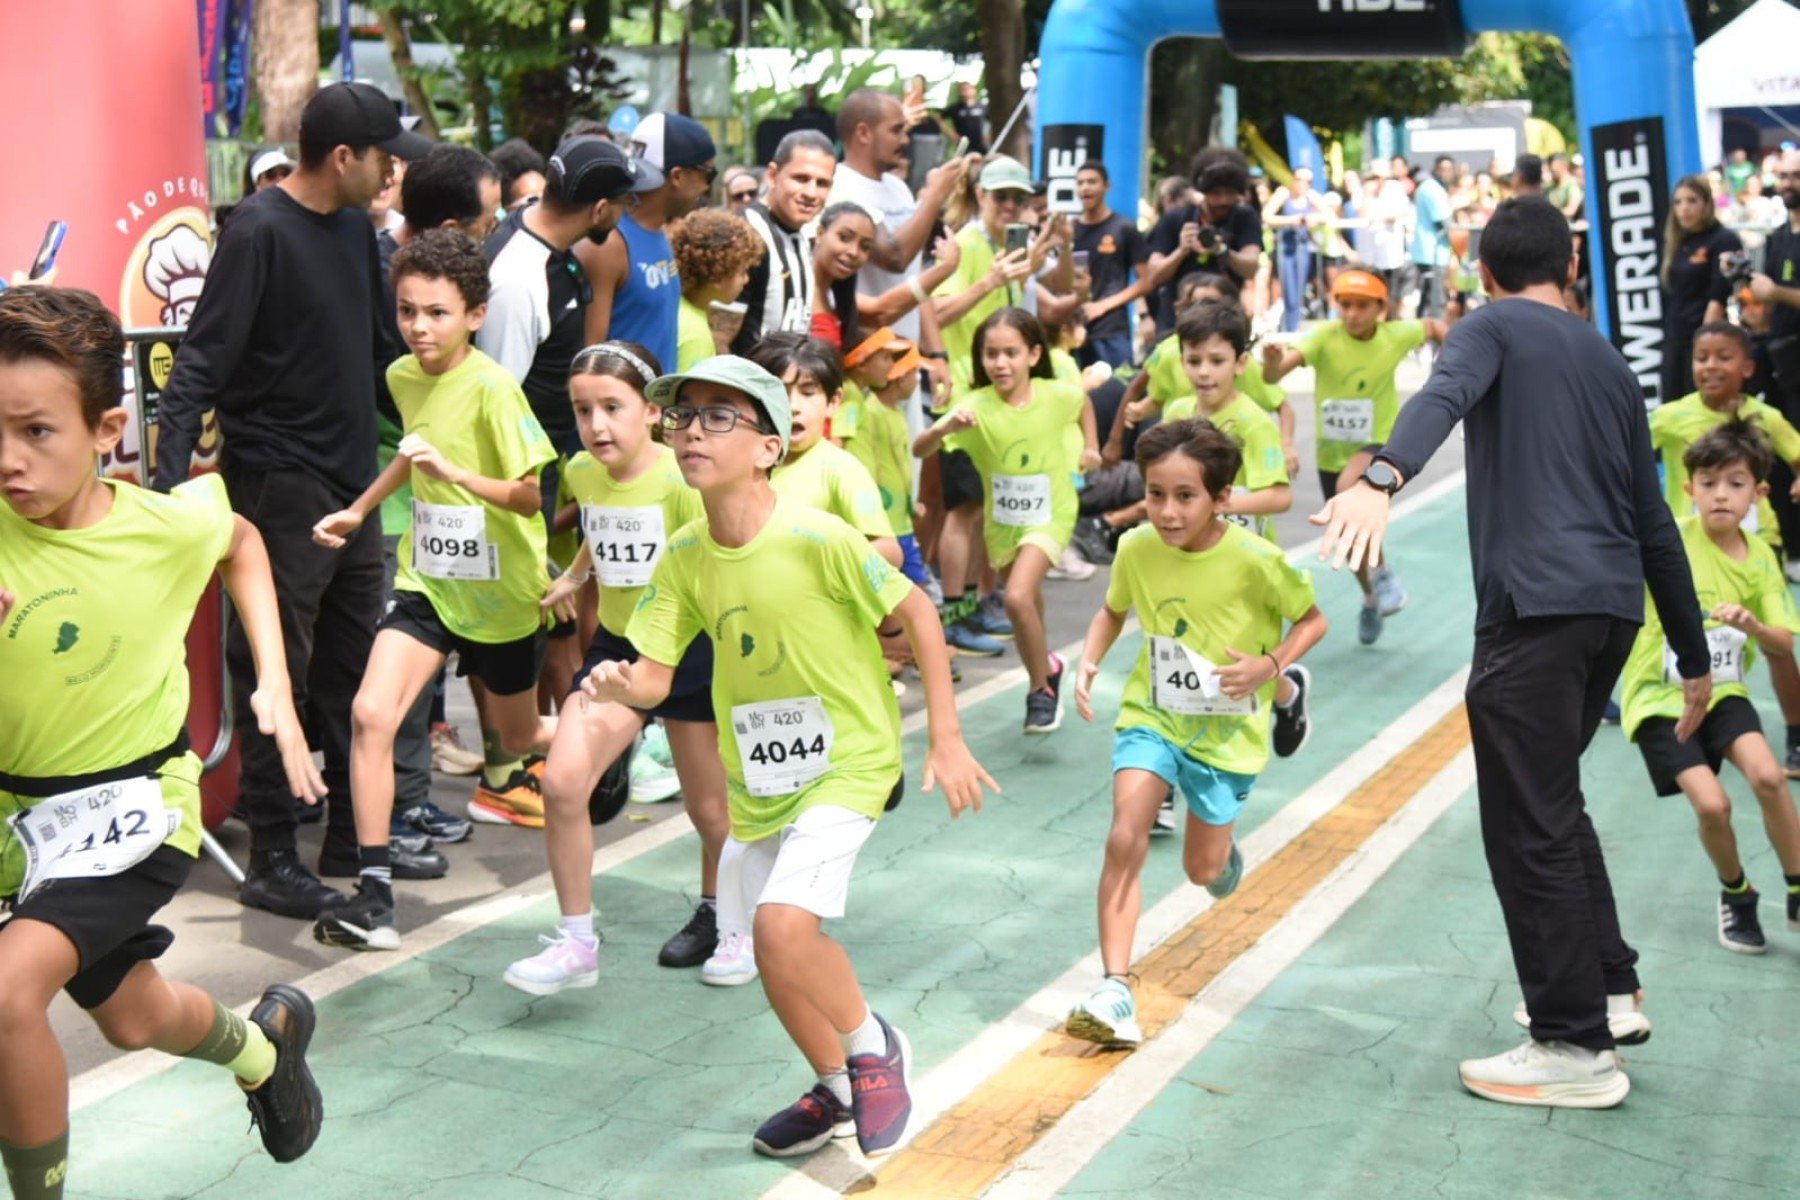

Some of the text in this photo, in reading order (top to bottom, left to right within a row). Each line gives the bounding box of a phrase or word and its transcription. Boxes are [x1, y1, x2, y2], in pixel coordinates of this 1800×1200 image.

[163, 177, 186, 197] DE
[1604, 145, 1663, 413] WERADE
[1325, 417, 1368, 430] 4157
[997, 496, 1044, 510] 4097
[616, 520, 641, 532] 420
[420, 535, 479, 558] 4098
[595, 541, 657, 563] 4117
[8, 586, 79, 640] MARATONINHA
[1713, 650, 1732, 669] 91
[1166, 670, 1201, 691] 40
[773, 710, 804, 726] 420
[749, 733, 825, 766] 4044
[88, 784, 123, 812] 420
